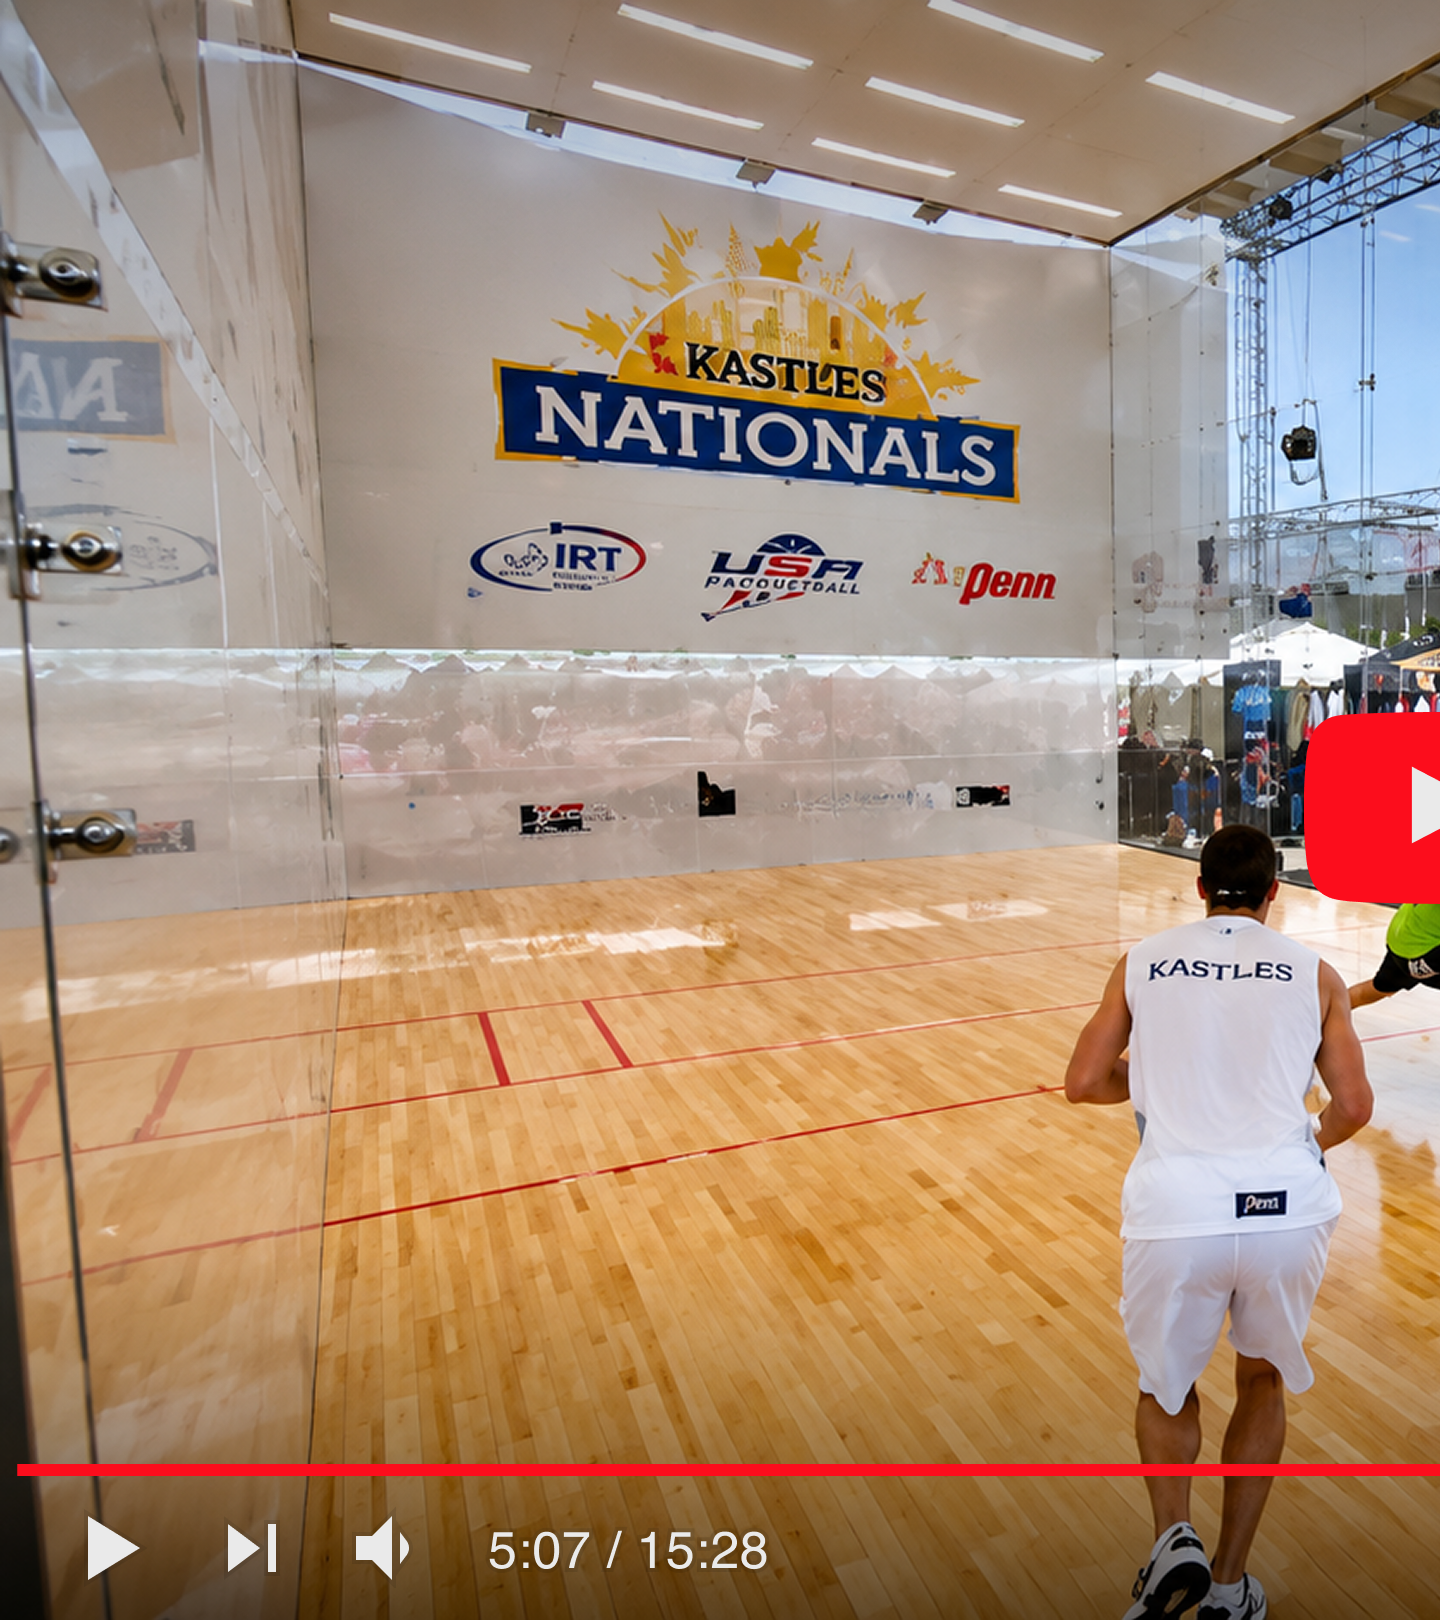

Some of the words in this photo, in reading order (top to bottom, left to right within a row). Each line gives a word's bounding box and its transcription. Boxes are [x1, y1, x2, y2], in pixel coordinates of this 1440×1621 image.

[684, 341, 887, 404] KASTLES
[535, 384, 997, 487] NATIONALS
[555, 543, 622, 572] IRT
[711, 551, 864, 581] USA
[1148, 958, 1293, 982] KASTLES
